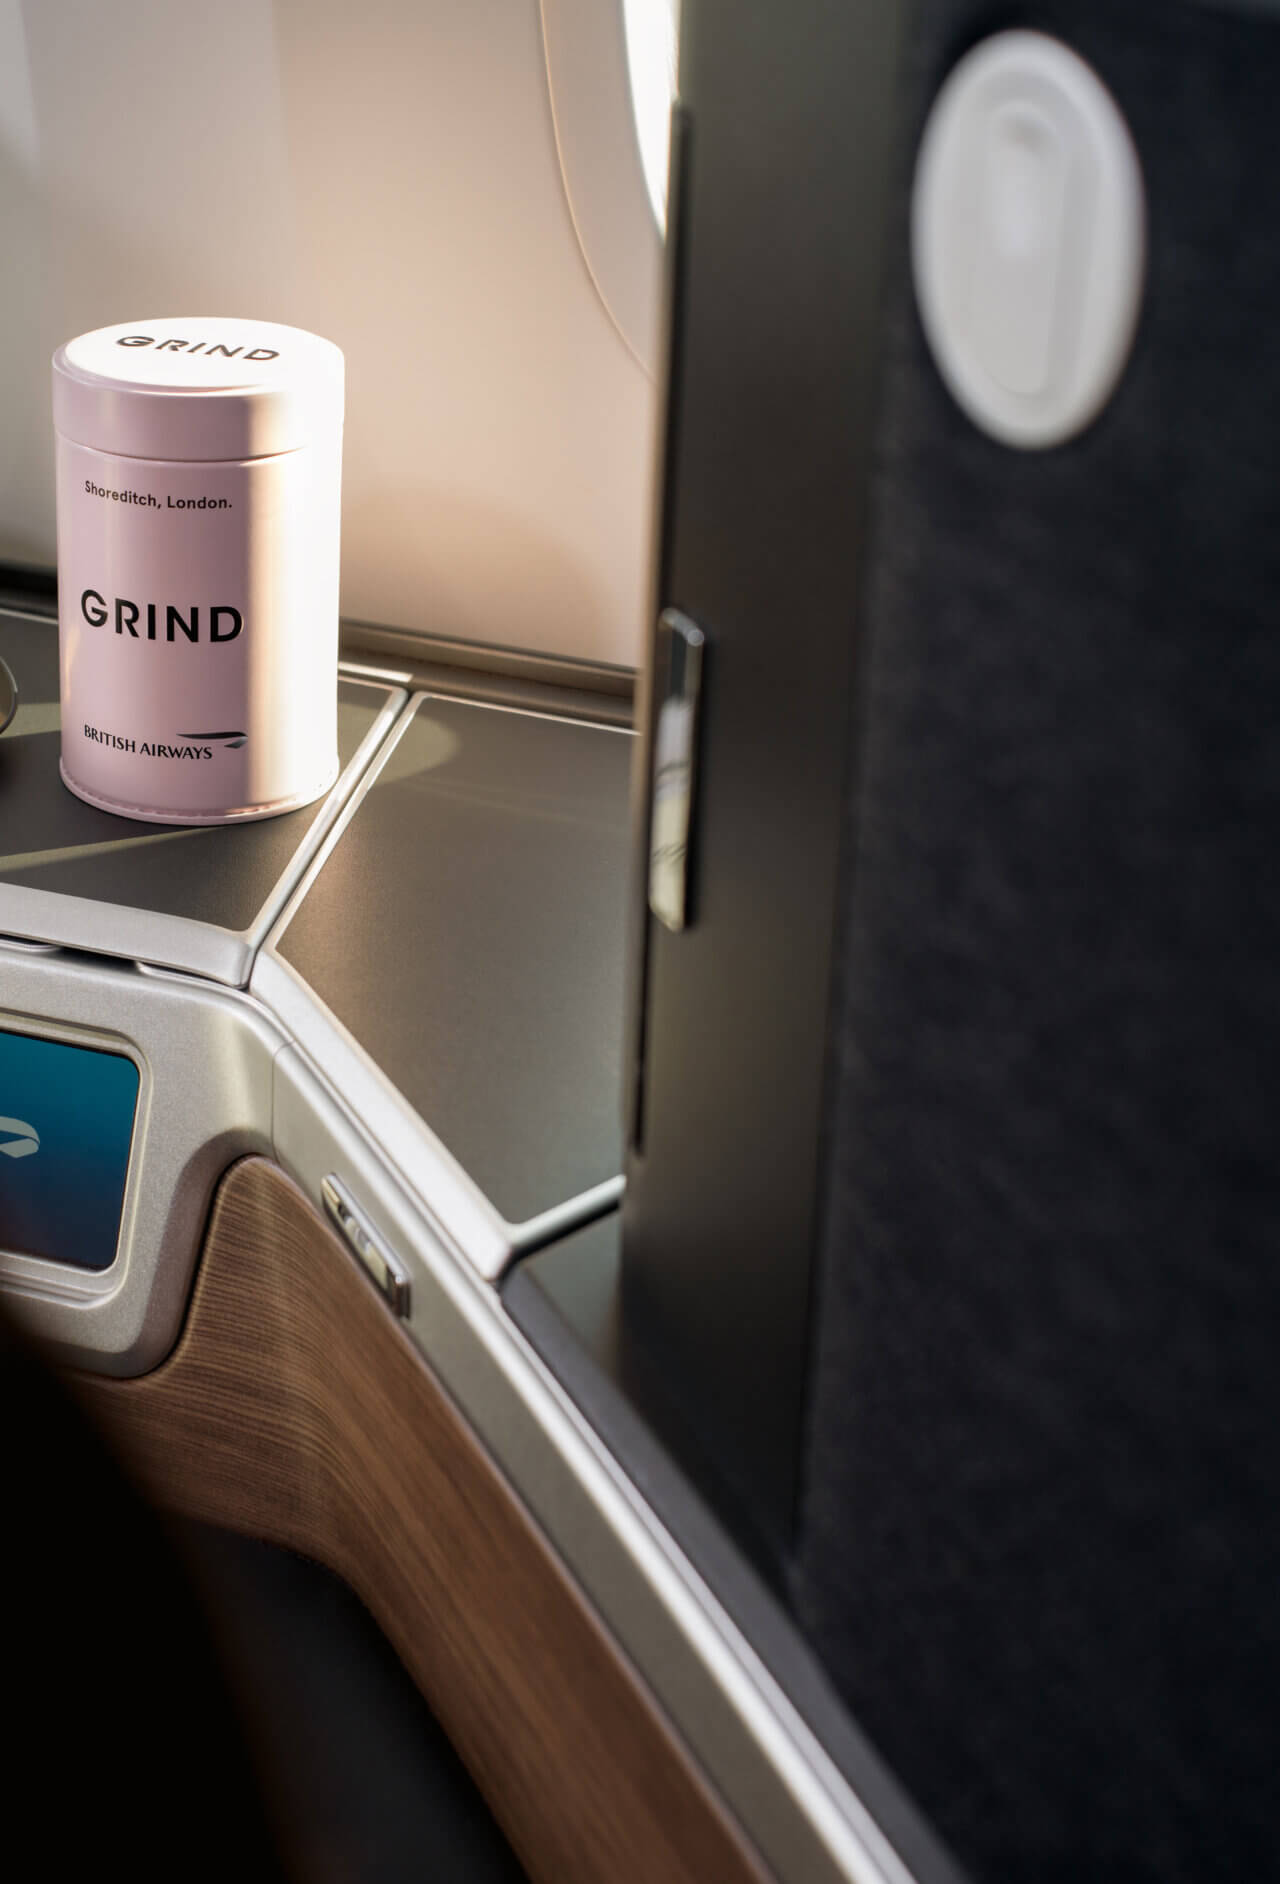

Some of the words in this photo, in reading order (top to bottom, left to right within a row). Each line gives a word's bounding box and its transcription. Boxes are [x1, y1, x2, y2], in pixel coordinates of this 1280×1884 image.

[116, 335, 280, 361] GRIND
[84, 480, 162, 510] Shoreditch,
[167, 495, 232, 510] London.
[81, 589, 243, 643] GRIND
[84, 724, 136, 753] BRITISH
[139, 742, 213, 760] AIRWAYS
